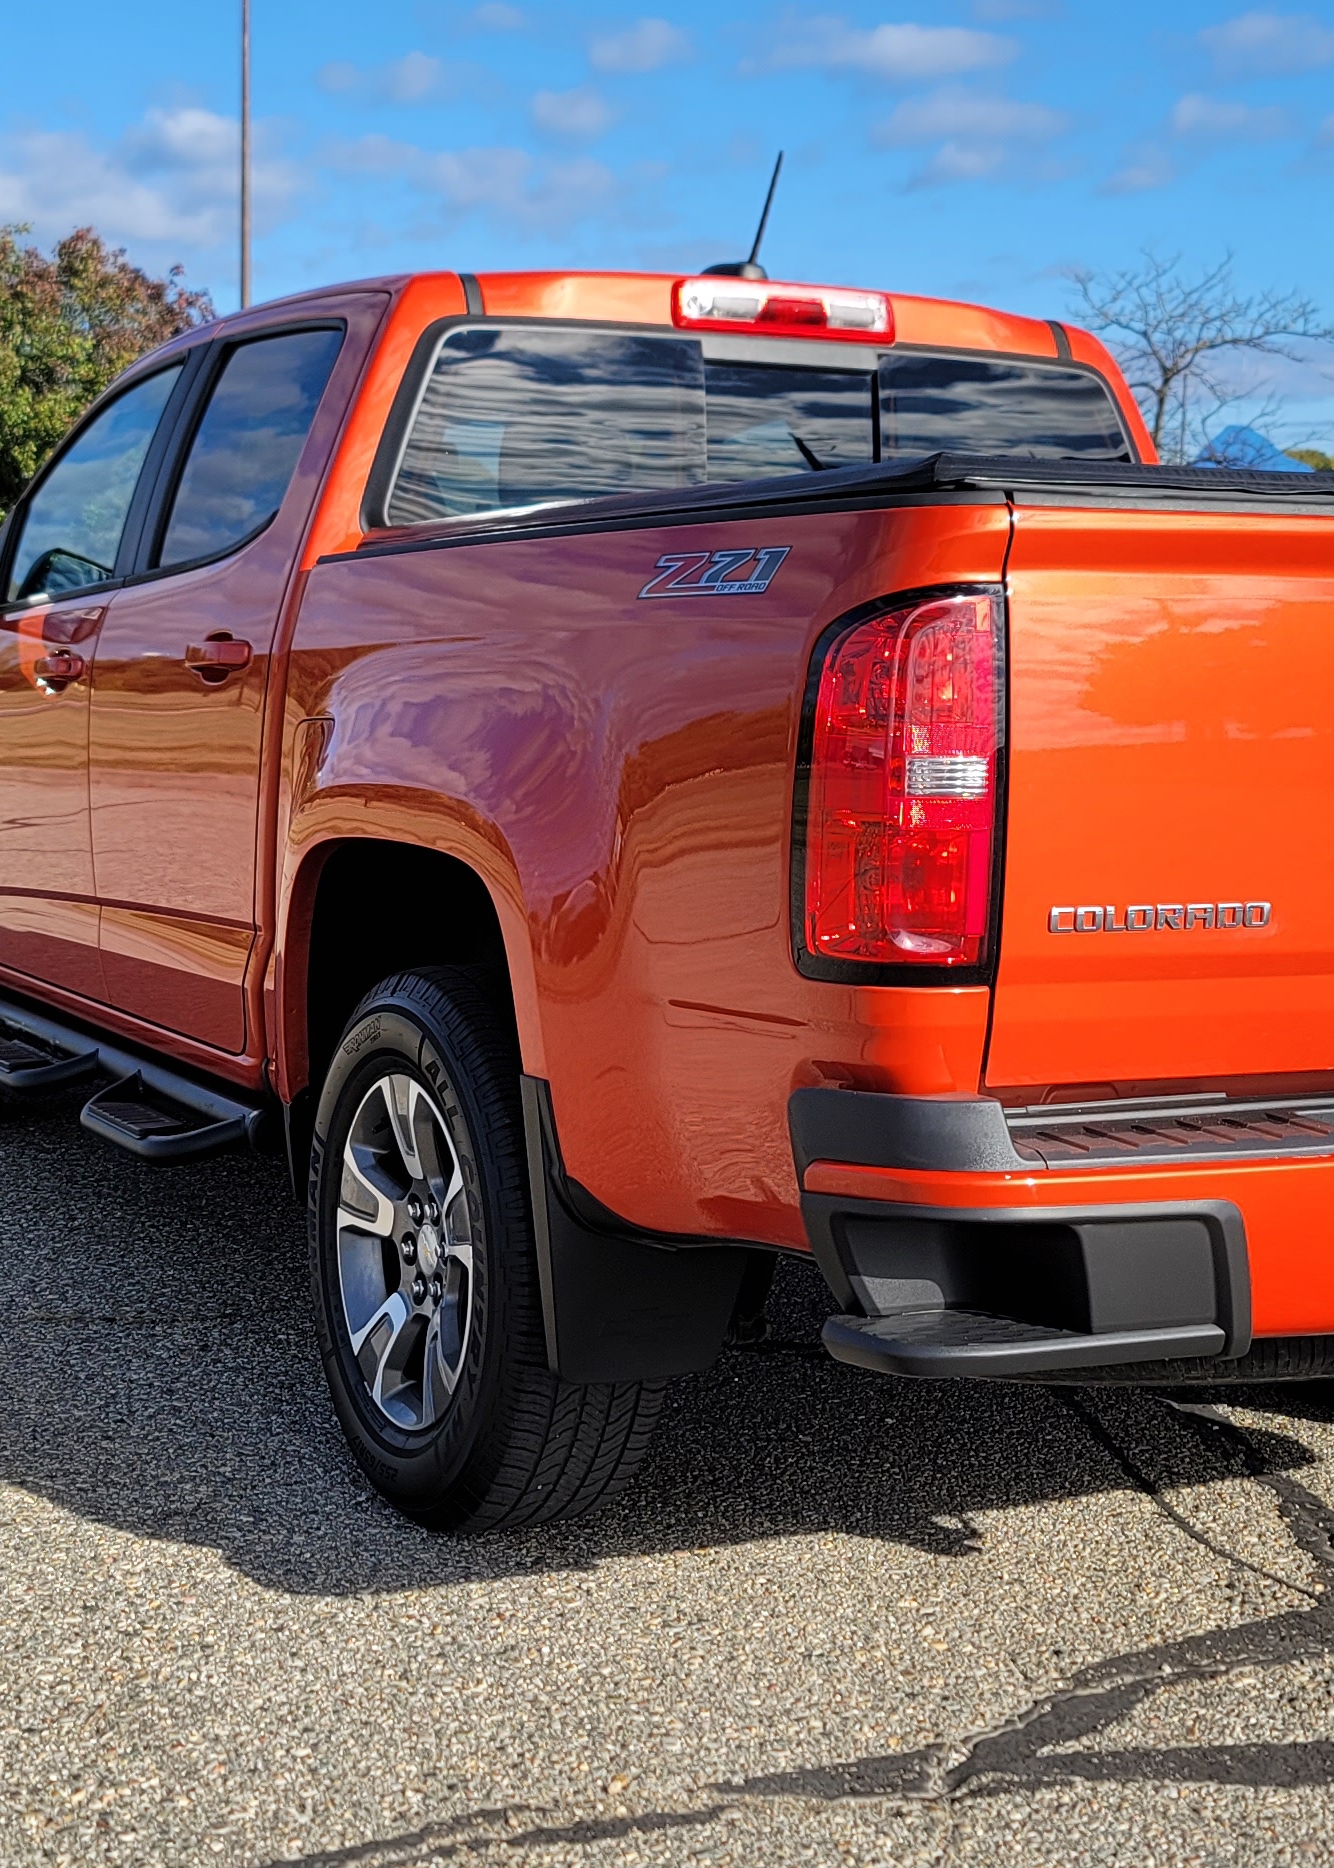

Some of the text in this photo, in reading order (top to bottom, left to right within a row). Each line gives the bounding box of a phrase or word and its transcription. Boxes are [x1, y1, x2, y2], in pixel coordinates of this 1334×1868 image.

[637, 546, 793, 600] Z71
[716, 582, 767, 592] OFF ROAD
[1048, 902, 1272, 933] COLORADO
[423, 1059, 457, 1132] ALL
